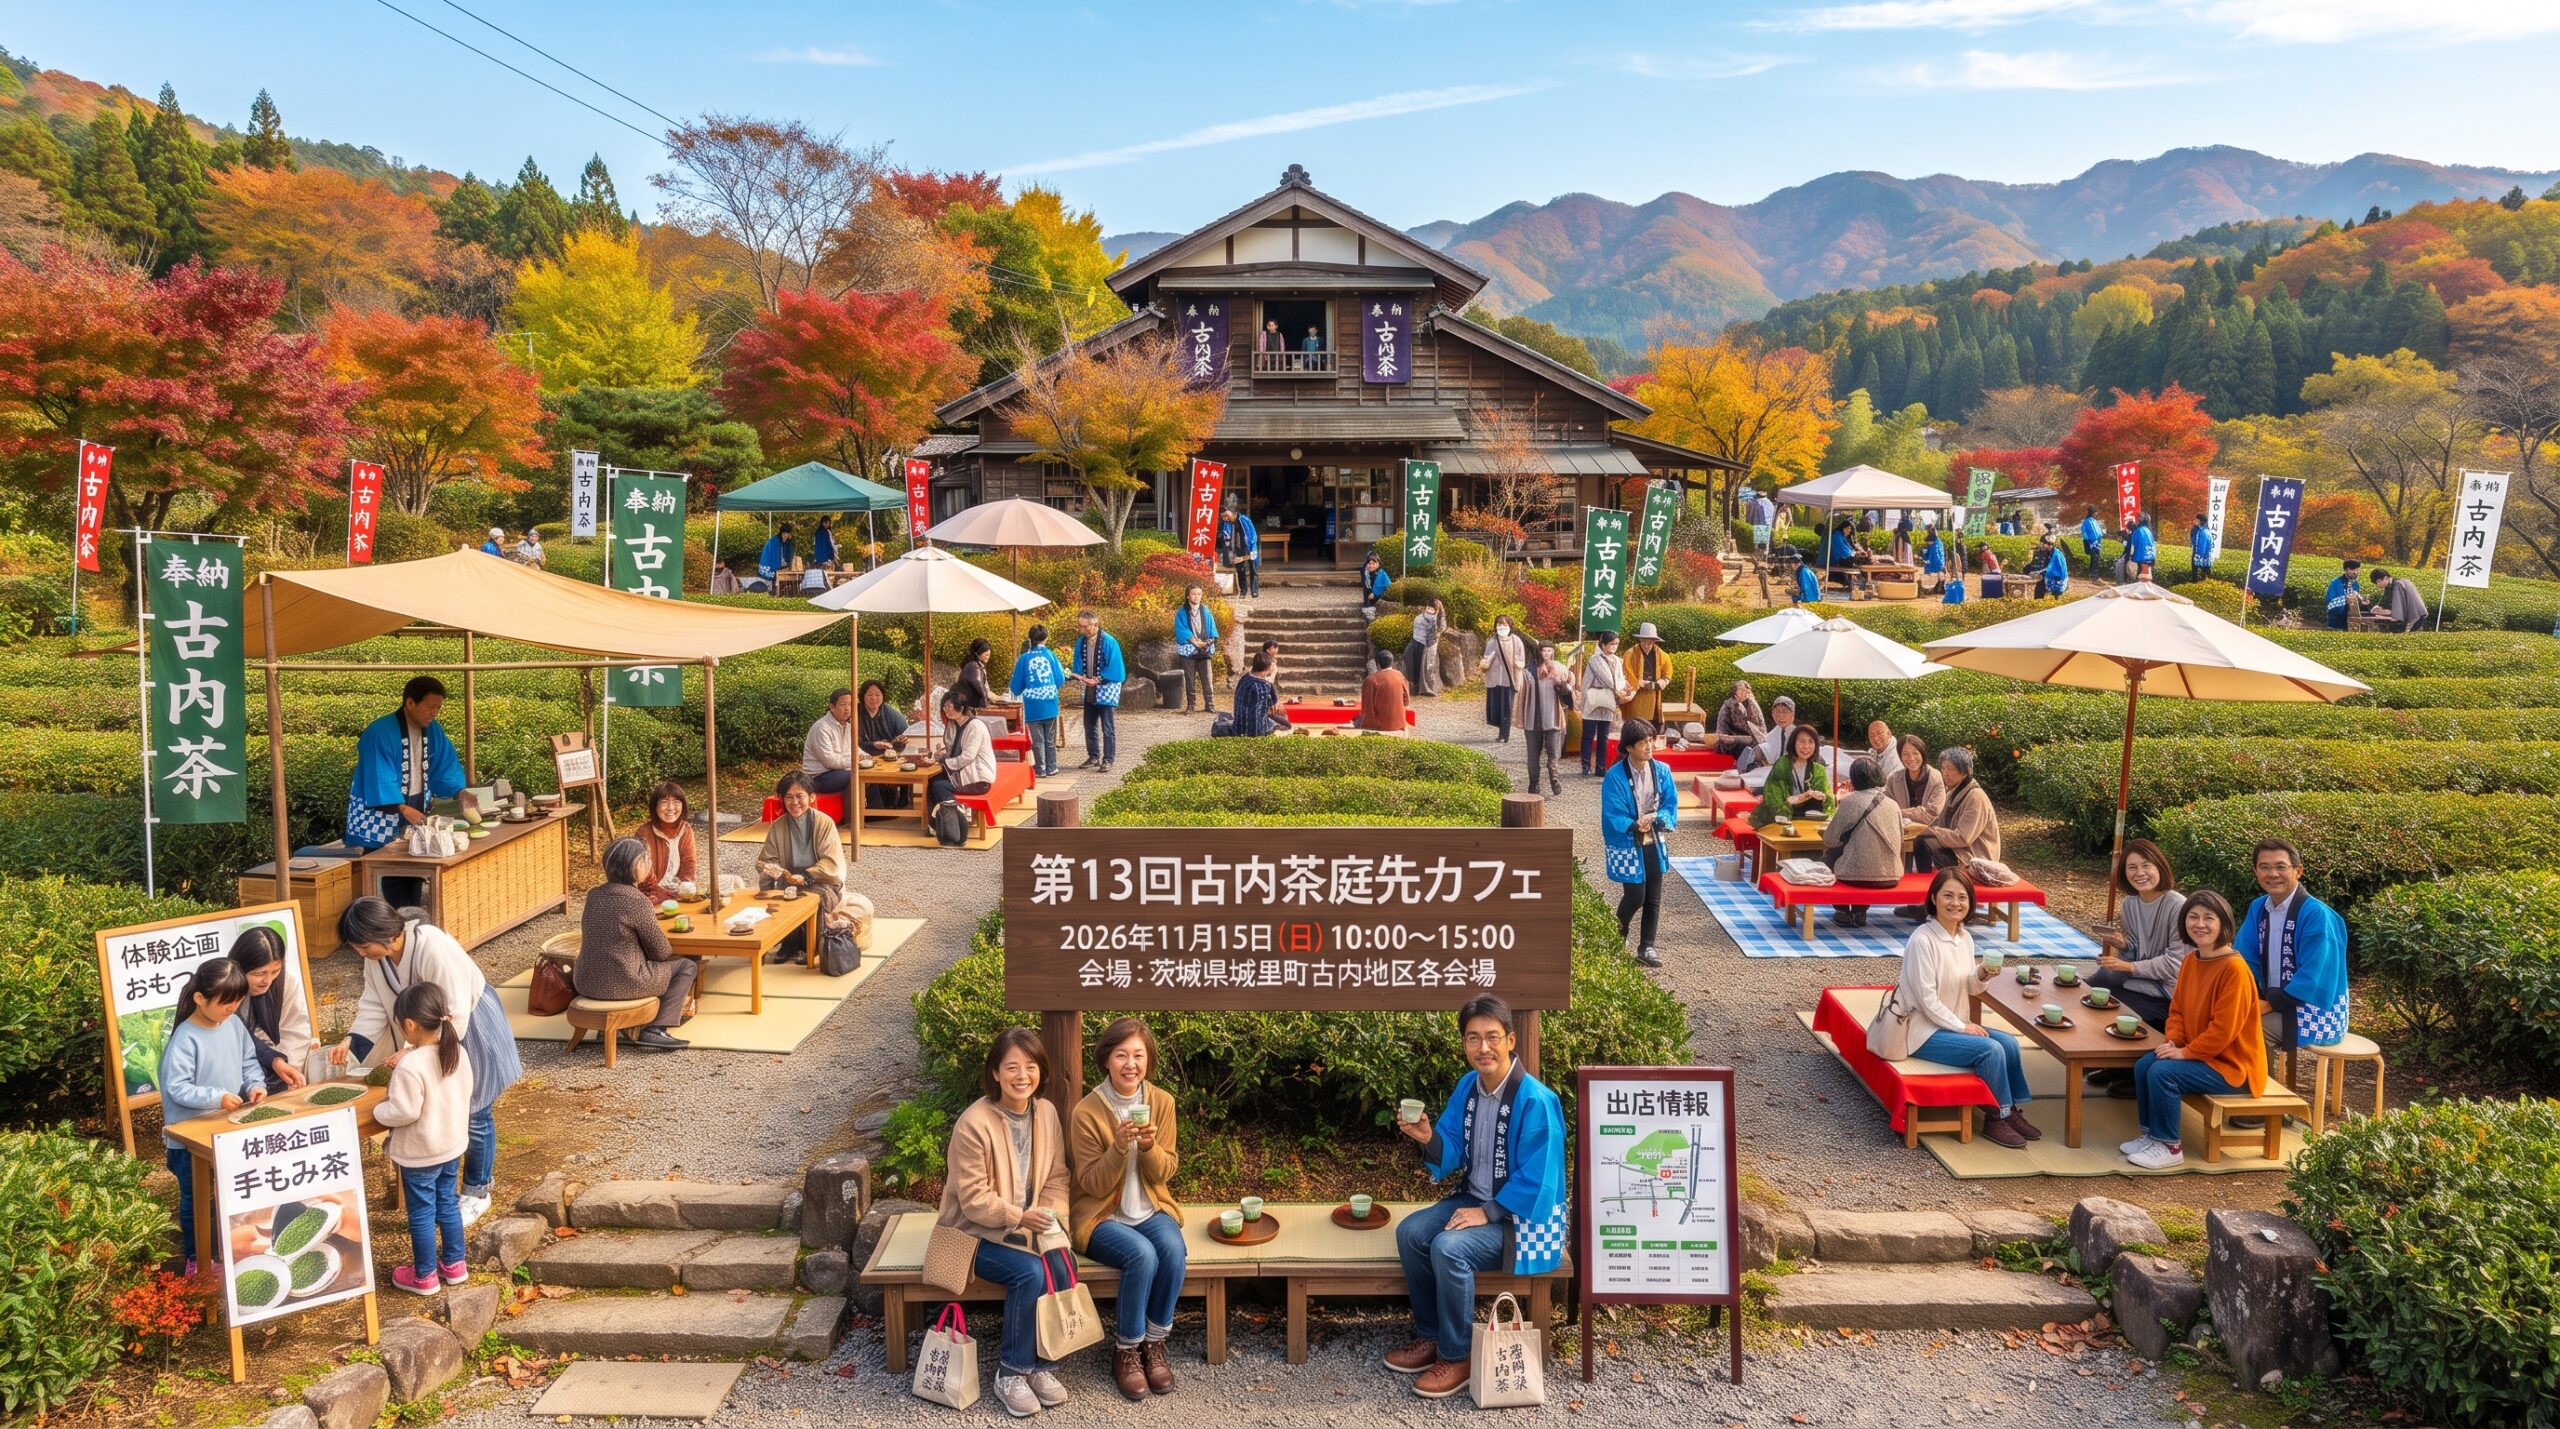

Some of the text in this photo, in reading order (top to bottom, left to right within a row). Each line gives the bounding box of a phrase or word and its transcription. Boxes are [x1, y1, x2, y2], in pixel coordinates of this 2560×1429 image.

[1191, 321, 1214, 377] 古内茶
[1374, 321, 1398, 377] 古内茶
[80, 471, 103, 559] 古内茶
[578, 471, 593, 528] 古内茶
[624, 487, 676, 515] 奉納
[1192, 483, 1217, 547] 古内茶
[1409, 484, 1434, 558] 古内茶
[1638, 510, 1668, 577] 古内茶
[2252, 504, 2291, 583] 古内茶
[2455, 499, 2494, 578] 古内茶
[160, 553, 229, 589] 奉納
[1587, 536, 1622, 619] 古内茶
[161, 600, 239, 800] 古内茶
[1030, 853, 1542, 906] 第13回古内茶庭先カフェ
[121, 931, 220, 970] 体験企画
[1078, 957, 1497, 989] 会場：茨城県城里町古内地区各会場
[1607, 1089, 1710, 1117] 出店情報
[242, 1125, 330, 1160] 体験企画
[233, 1151, 350, 1199] 手もみ茶
